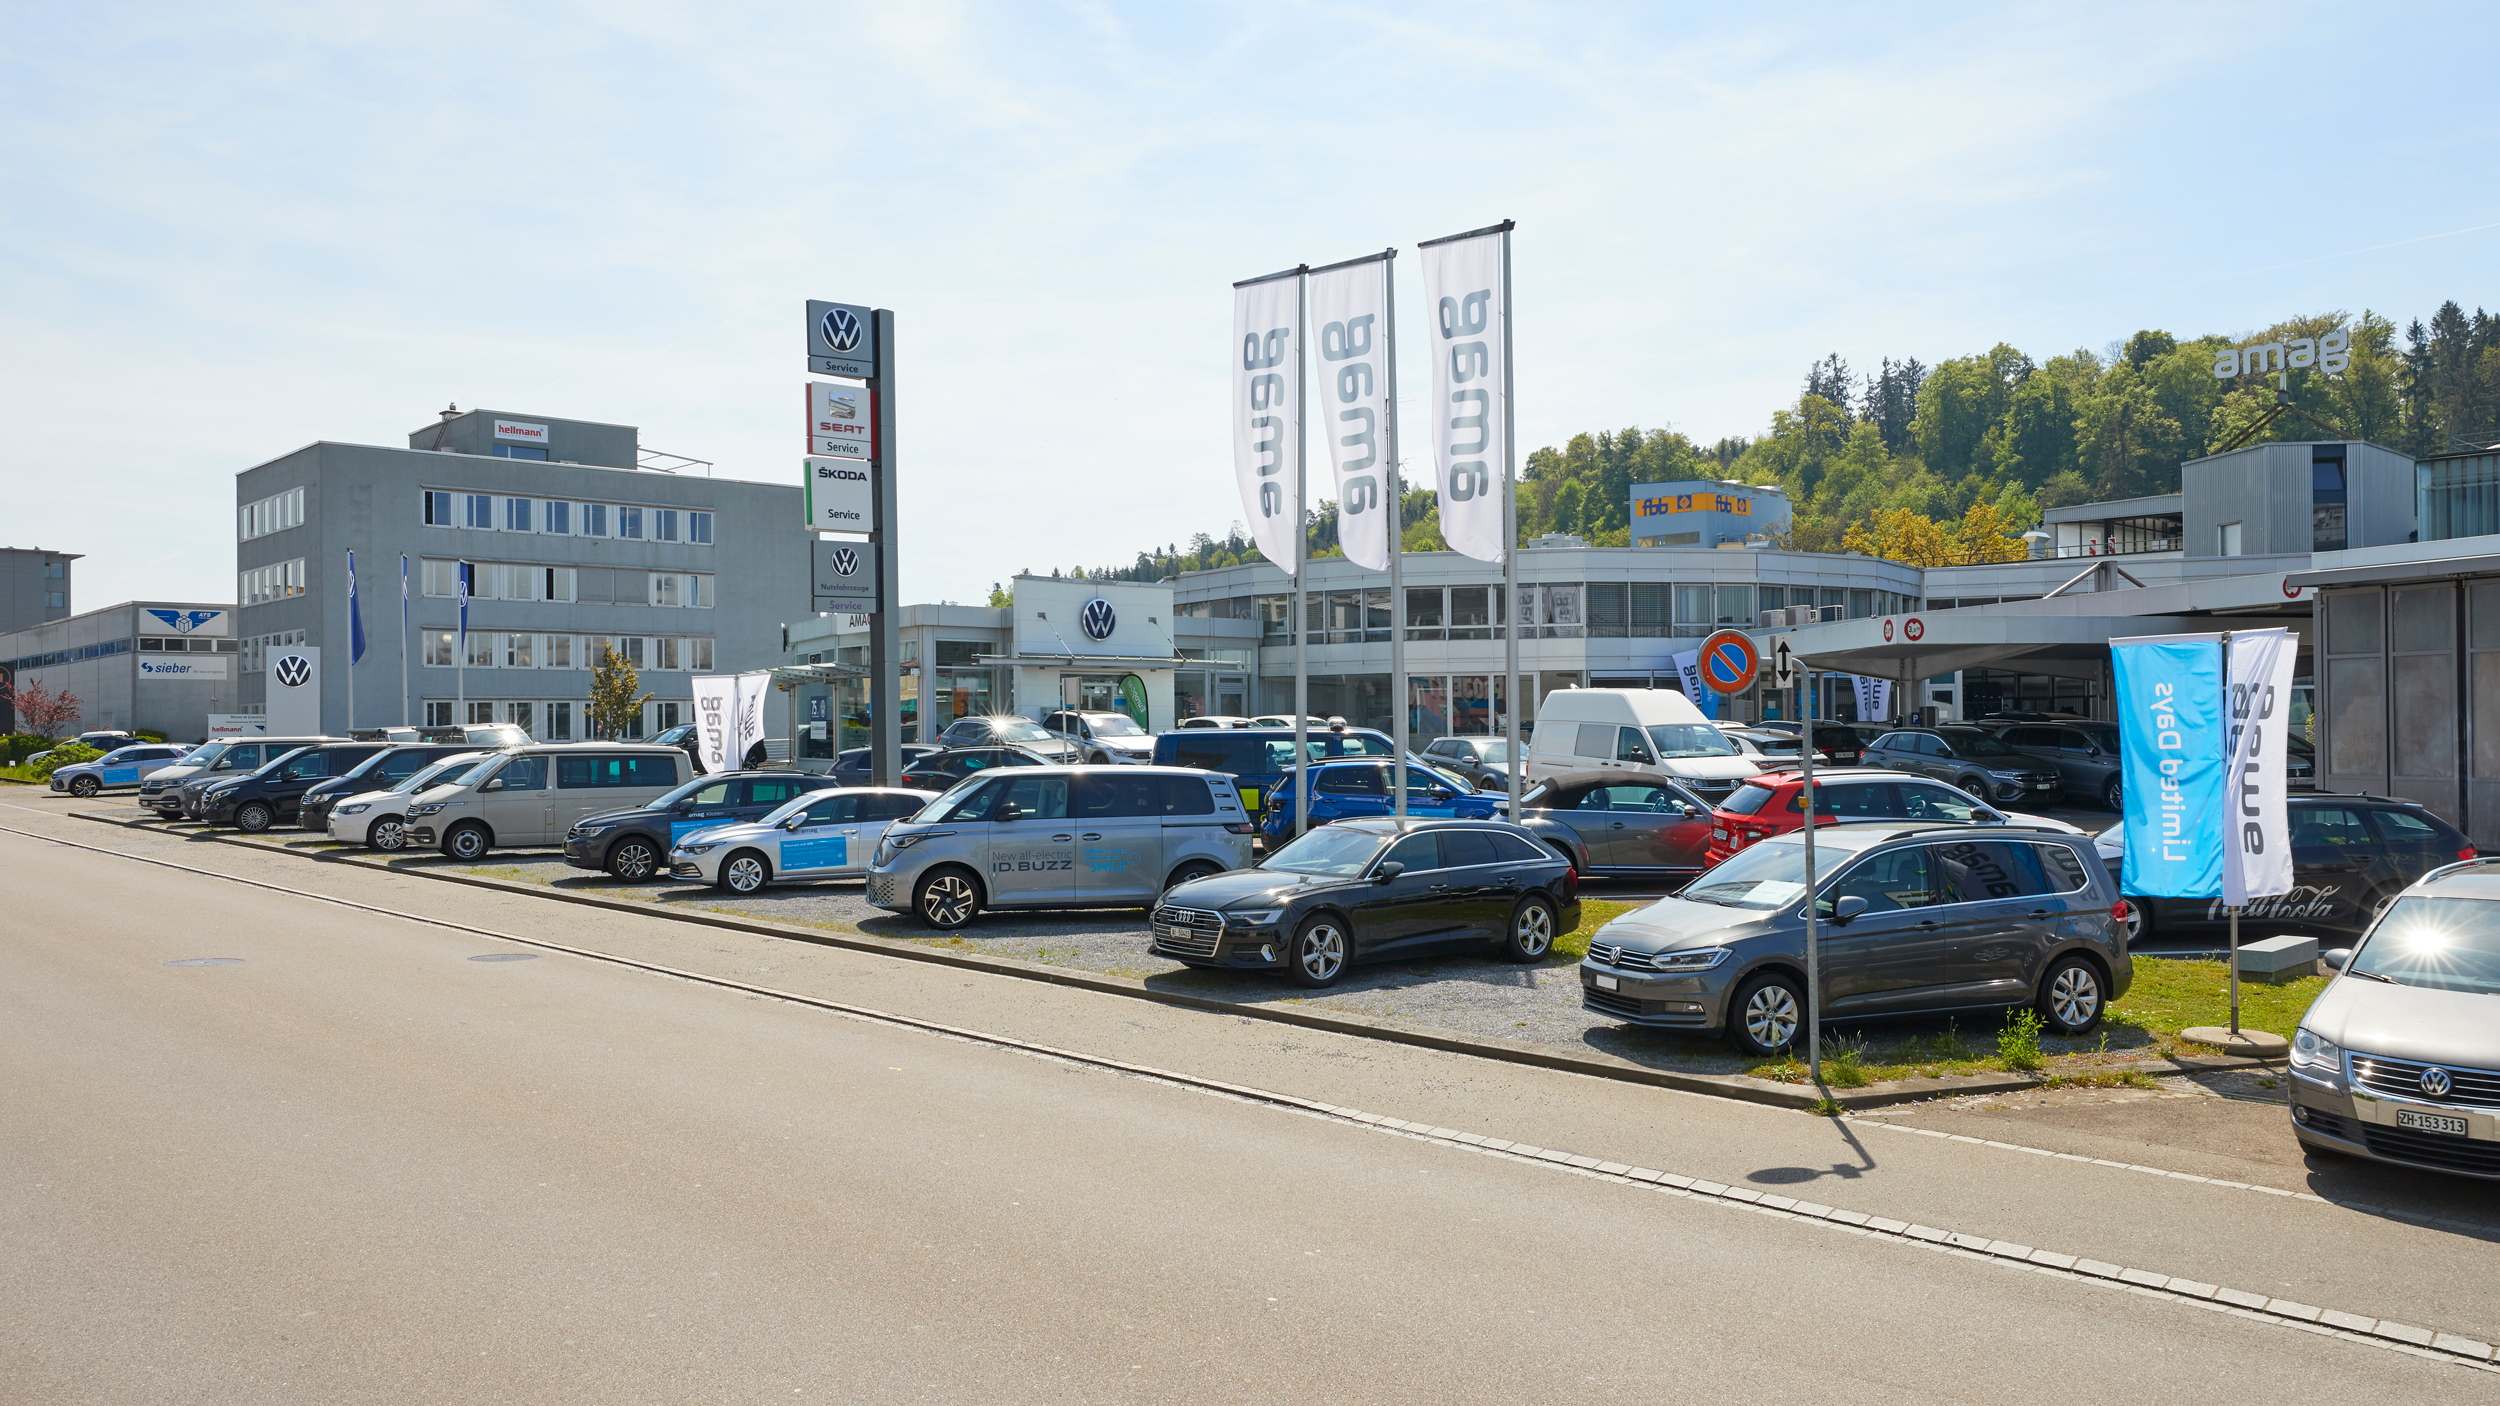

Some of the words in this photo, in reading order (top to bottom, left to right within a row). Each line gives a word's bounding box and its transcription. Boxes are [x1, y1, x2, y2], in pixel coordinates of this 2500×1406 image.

[2214, 328, 2349, 379] amag
[826, 361, 859, 373] Service
[498, 425, 542, 437] hellmann
[820, 422, 865, 434] SEAT
[827, 442, 859, 453] Service
[818, 467, 867, 481] ŠKODA
[828, 509, 860, 520] Service
[820, 583, 869, 592] Nutzfahrzeuge
[829, 600, 862, 610] Service
[155, 663, 192, 673] sieber
[992, 851, 1016, 861] New
[1020, 850, 1072, 861] all-electric
[1018, 860, 1072, 871] BUZZ
[1090, 862, 1126, 872] SMILE
